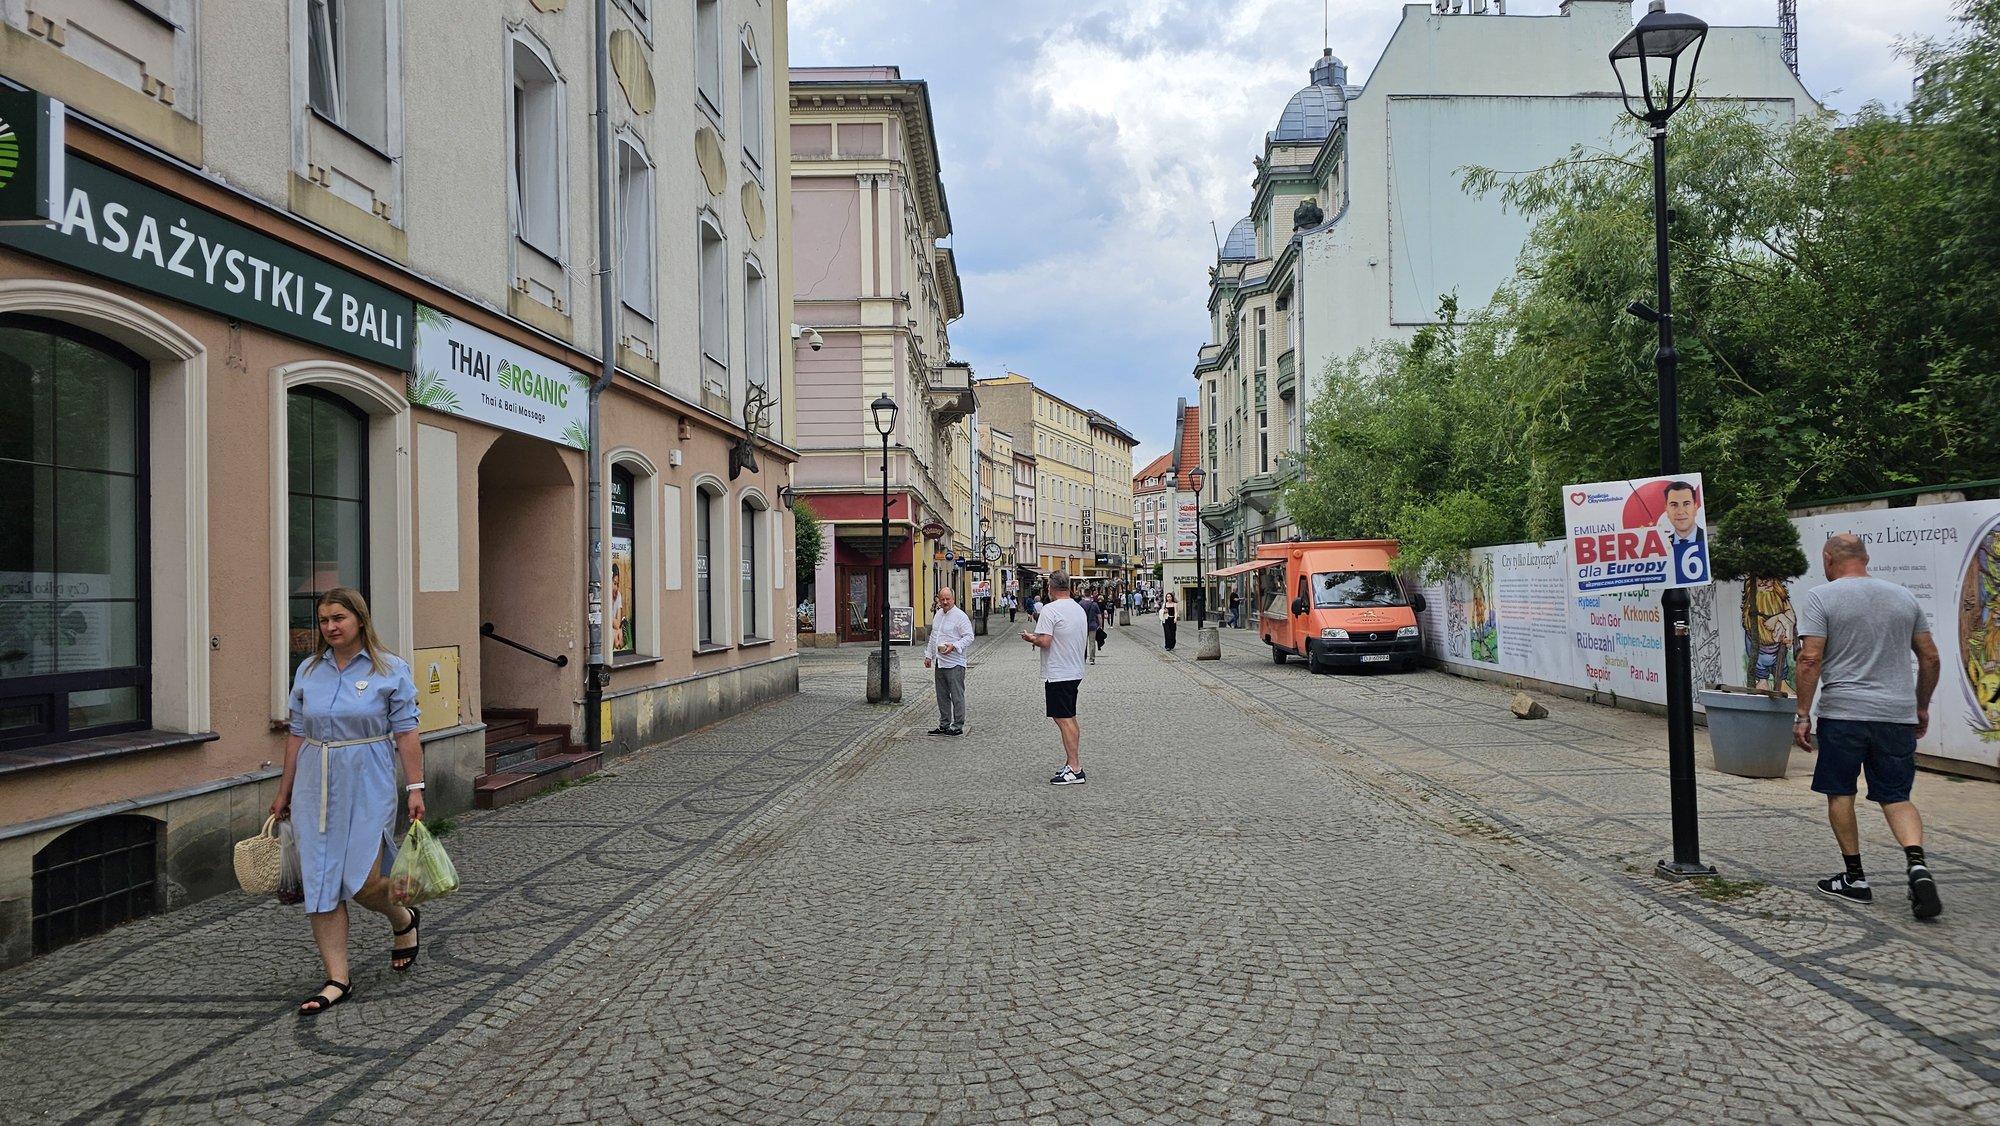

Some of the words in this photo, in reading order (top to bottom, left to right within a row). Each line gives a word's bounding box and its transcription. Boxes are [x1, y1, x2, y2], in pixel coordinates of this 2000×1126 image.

[50, 187, 303, 315] ASAŻYSTKI
[313, 281, 332, 325] Z
[341, 292, 402, 350] BALI
[448, 338, 491, 382] THAI
[497, 358, 568, 408] ORGANIC
[481, 393, 497, 407] Thai
[498, 398, 503, 408] &
[504, 400, 518, 414] Bali
[518, 406, 546, 424] Massage
[1083, 510, 1091, 551] HOTEL
[1573, 523, 1615, 536] EMILIAN
[1876, 532, 1883, 543] z
[1886, 526, 1958, 546] Liczyrzepą
[1502, 554, 1513, 570] Czy
[1513, 553, 1526, 570] tylko
[1526, 550, 1559, 570] Liczyrzepa?
[1574, 530, 1668, 565] BERA
[1681, 544, 1704, 580] 6
[1578, 565, 1602, 578] dla
[1606, 560, 1668, 575] Europy
[1586, 580, 1615, 588] BEZPIECZNA
[1577, 596, 1600, 610] Rybecal
[1590, 612, 1607, 626] Duch
[1607, 614, 1621, 628] Gór
[1623, 605, 1660, 623] Krkonoš
[1576, 632, 1615, 653] Rübezahl
[1616, 632, 1662, 650] Riphen-Zabel
[1630, 665, 1644, 681] Pan
[1646, 668, 1659, 683] Jan
